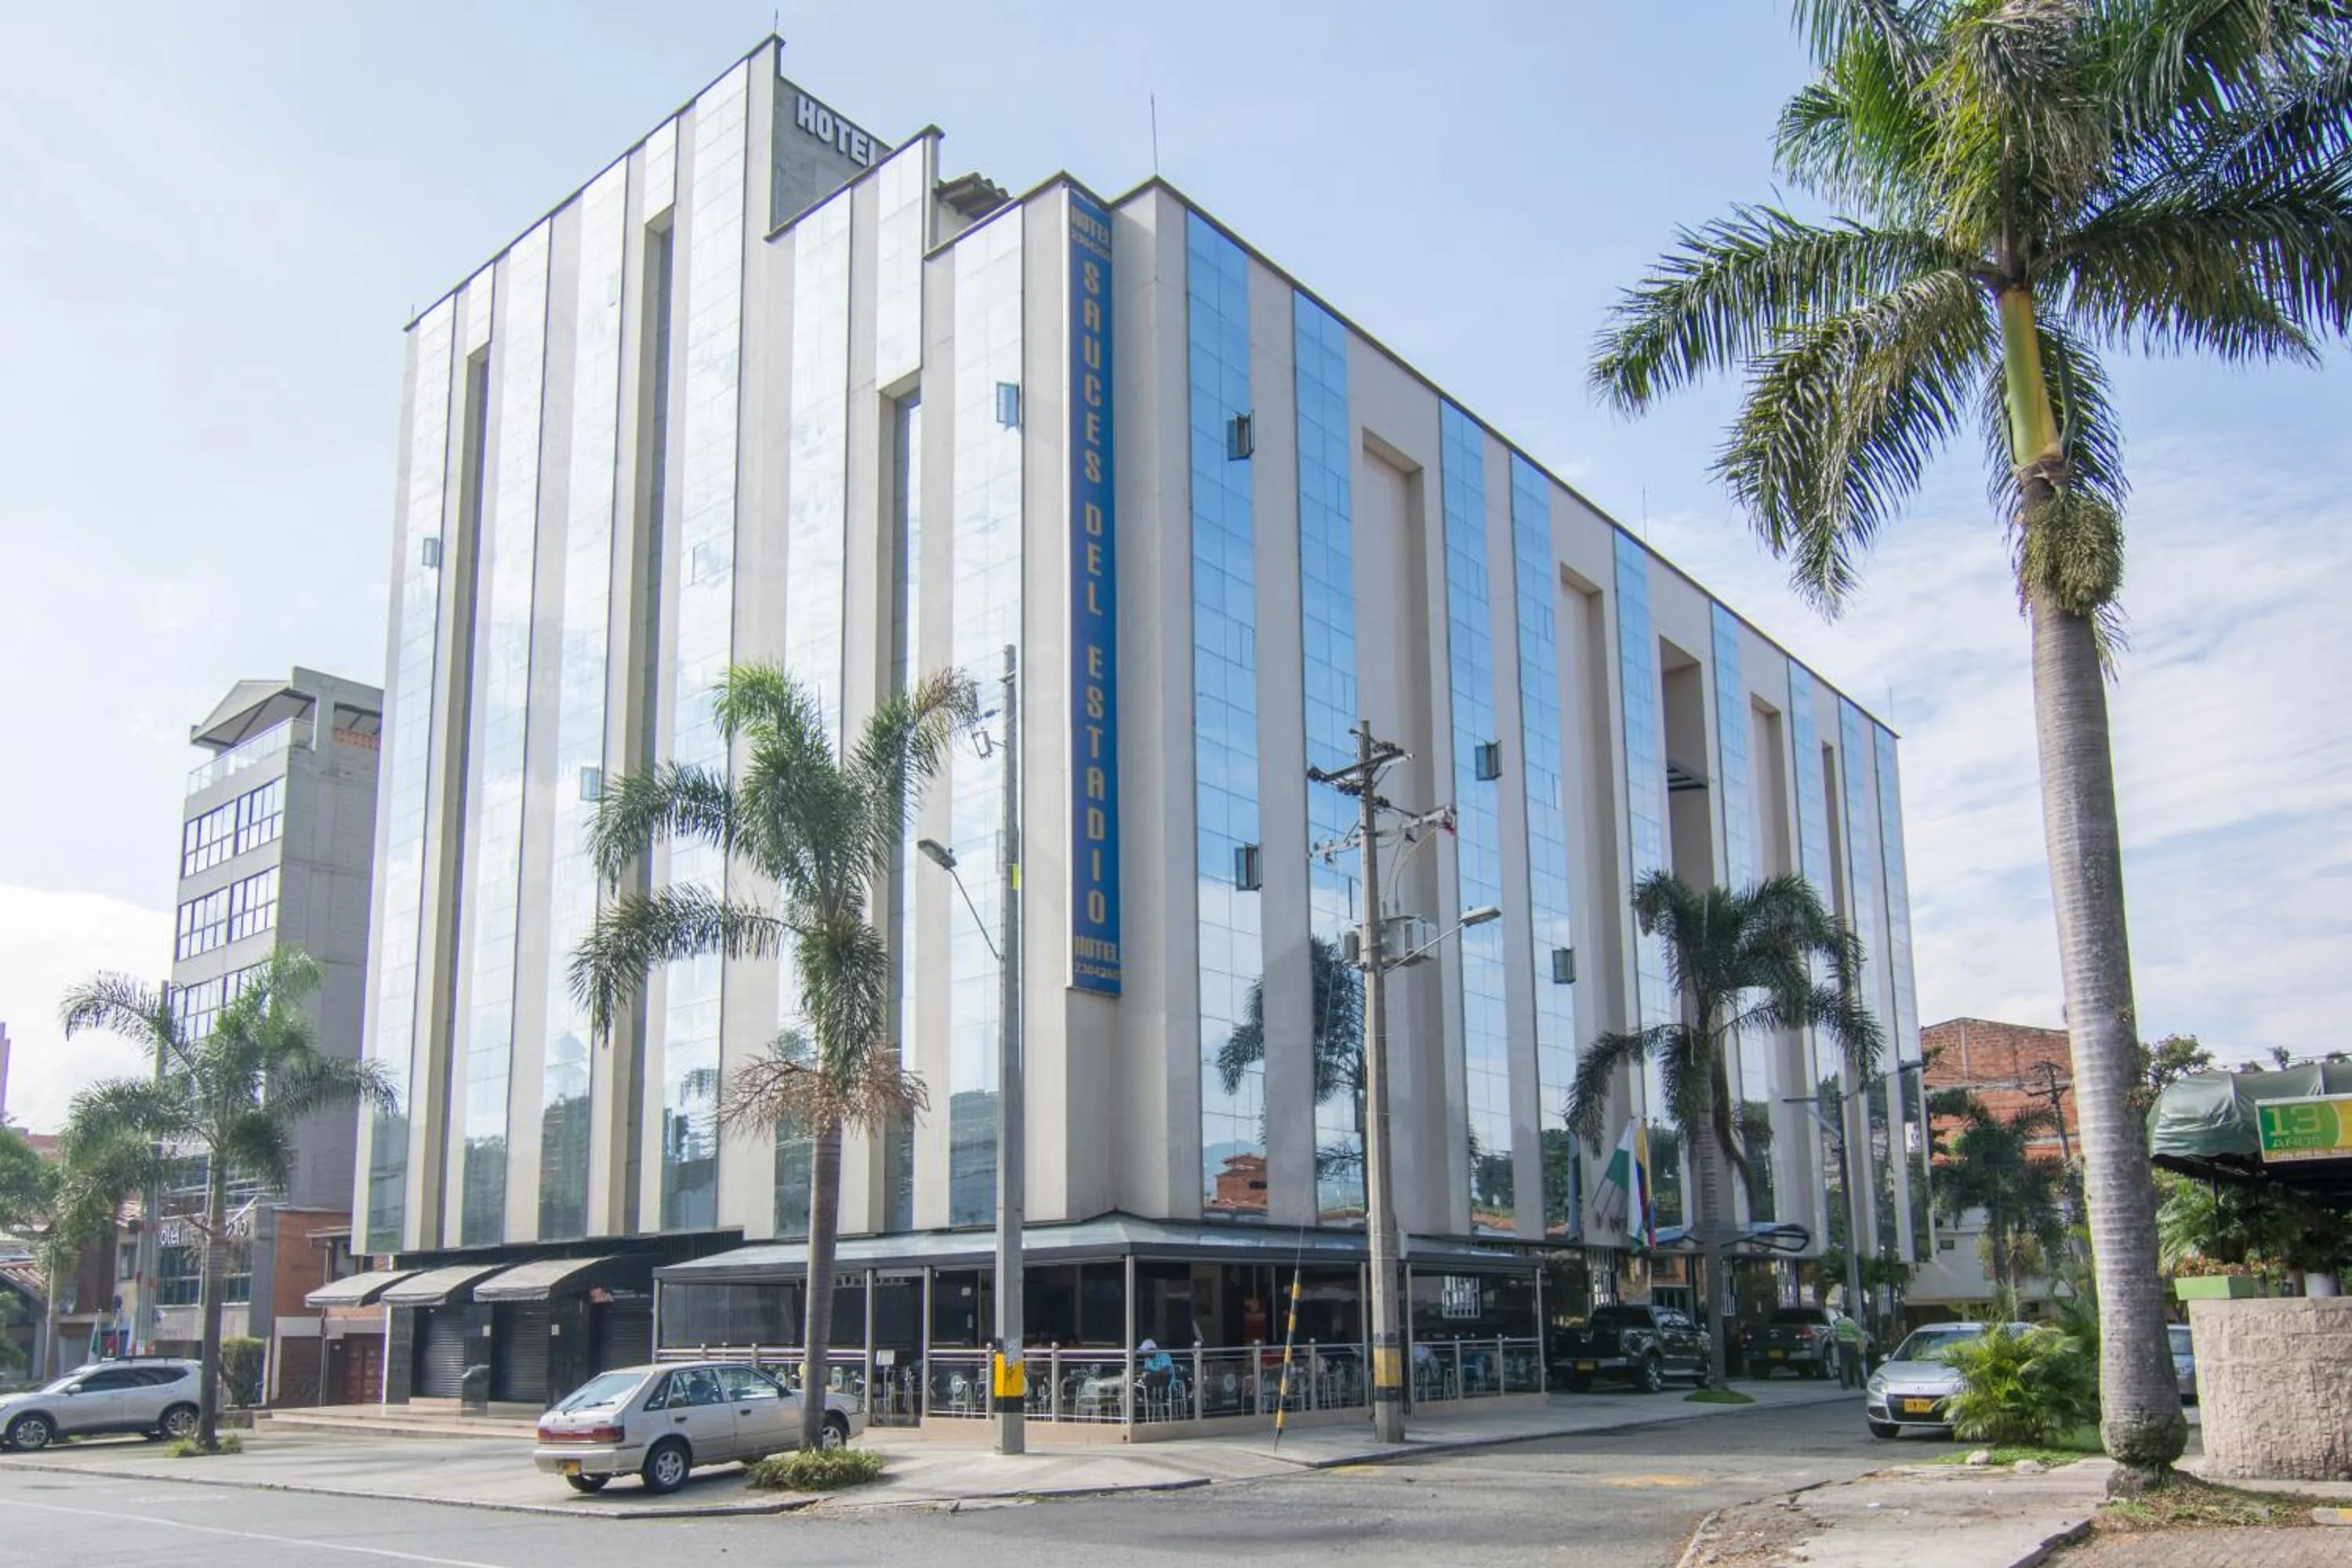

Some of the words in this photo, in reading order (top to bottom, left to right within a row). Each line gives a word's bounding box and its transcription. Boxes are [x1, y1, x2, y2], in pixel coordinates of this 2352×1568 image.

[1071, 205, 1110, 247] HOTEL
[1083, 261, 1102, 483] SAUCES
[1085, 502, 1102, 615] DEL
[1086, 644, 1105, 924] ESTADIO
[1073, 935, 1119, 964] HOTEL
[2266, 1104, 2321, 1137] 13
